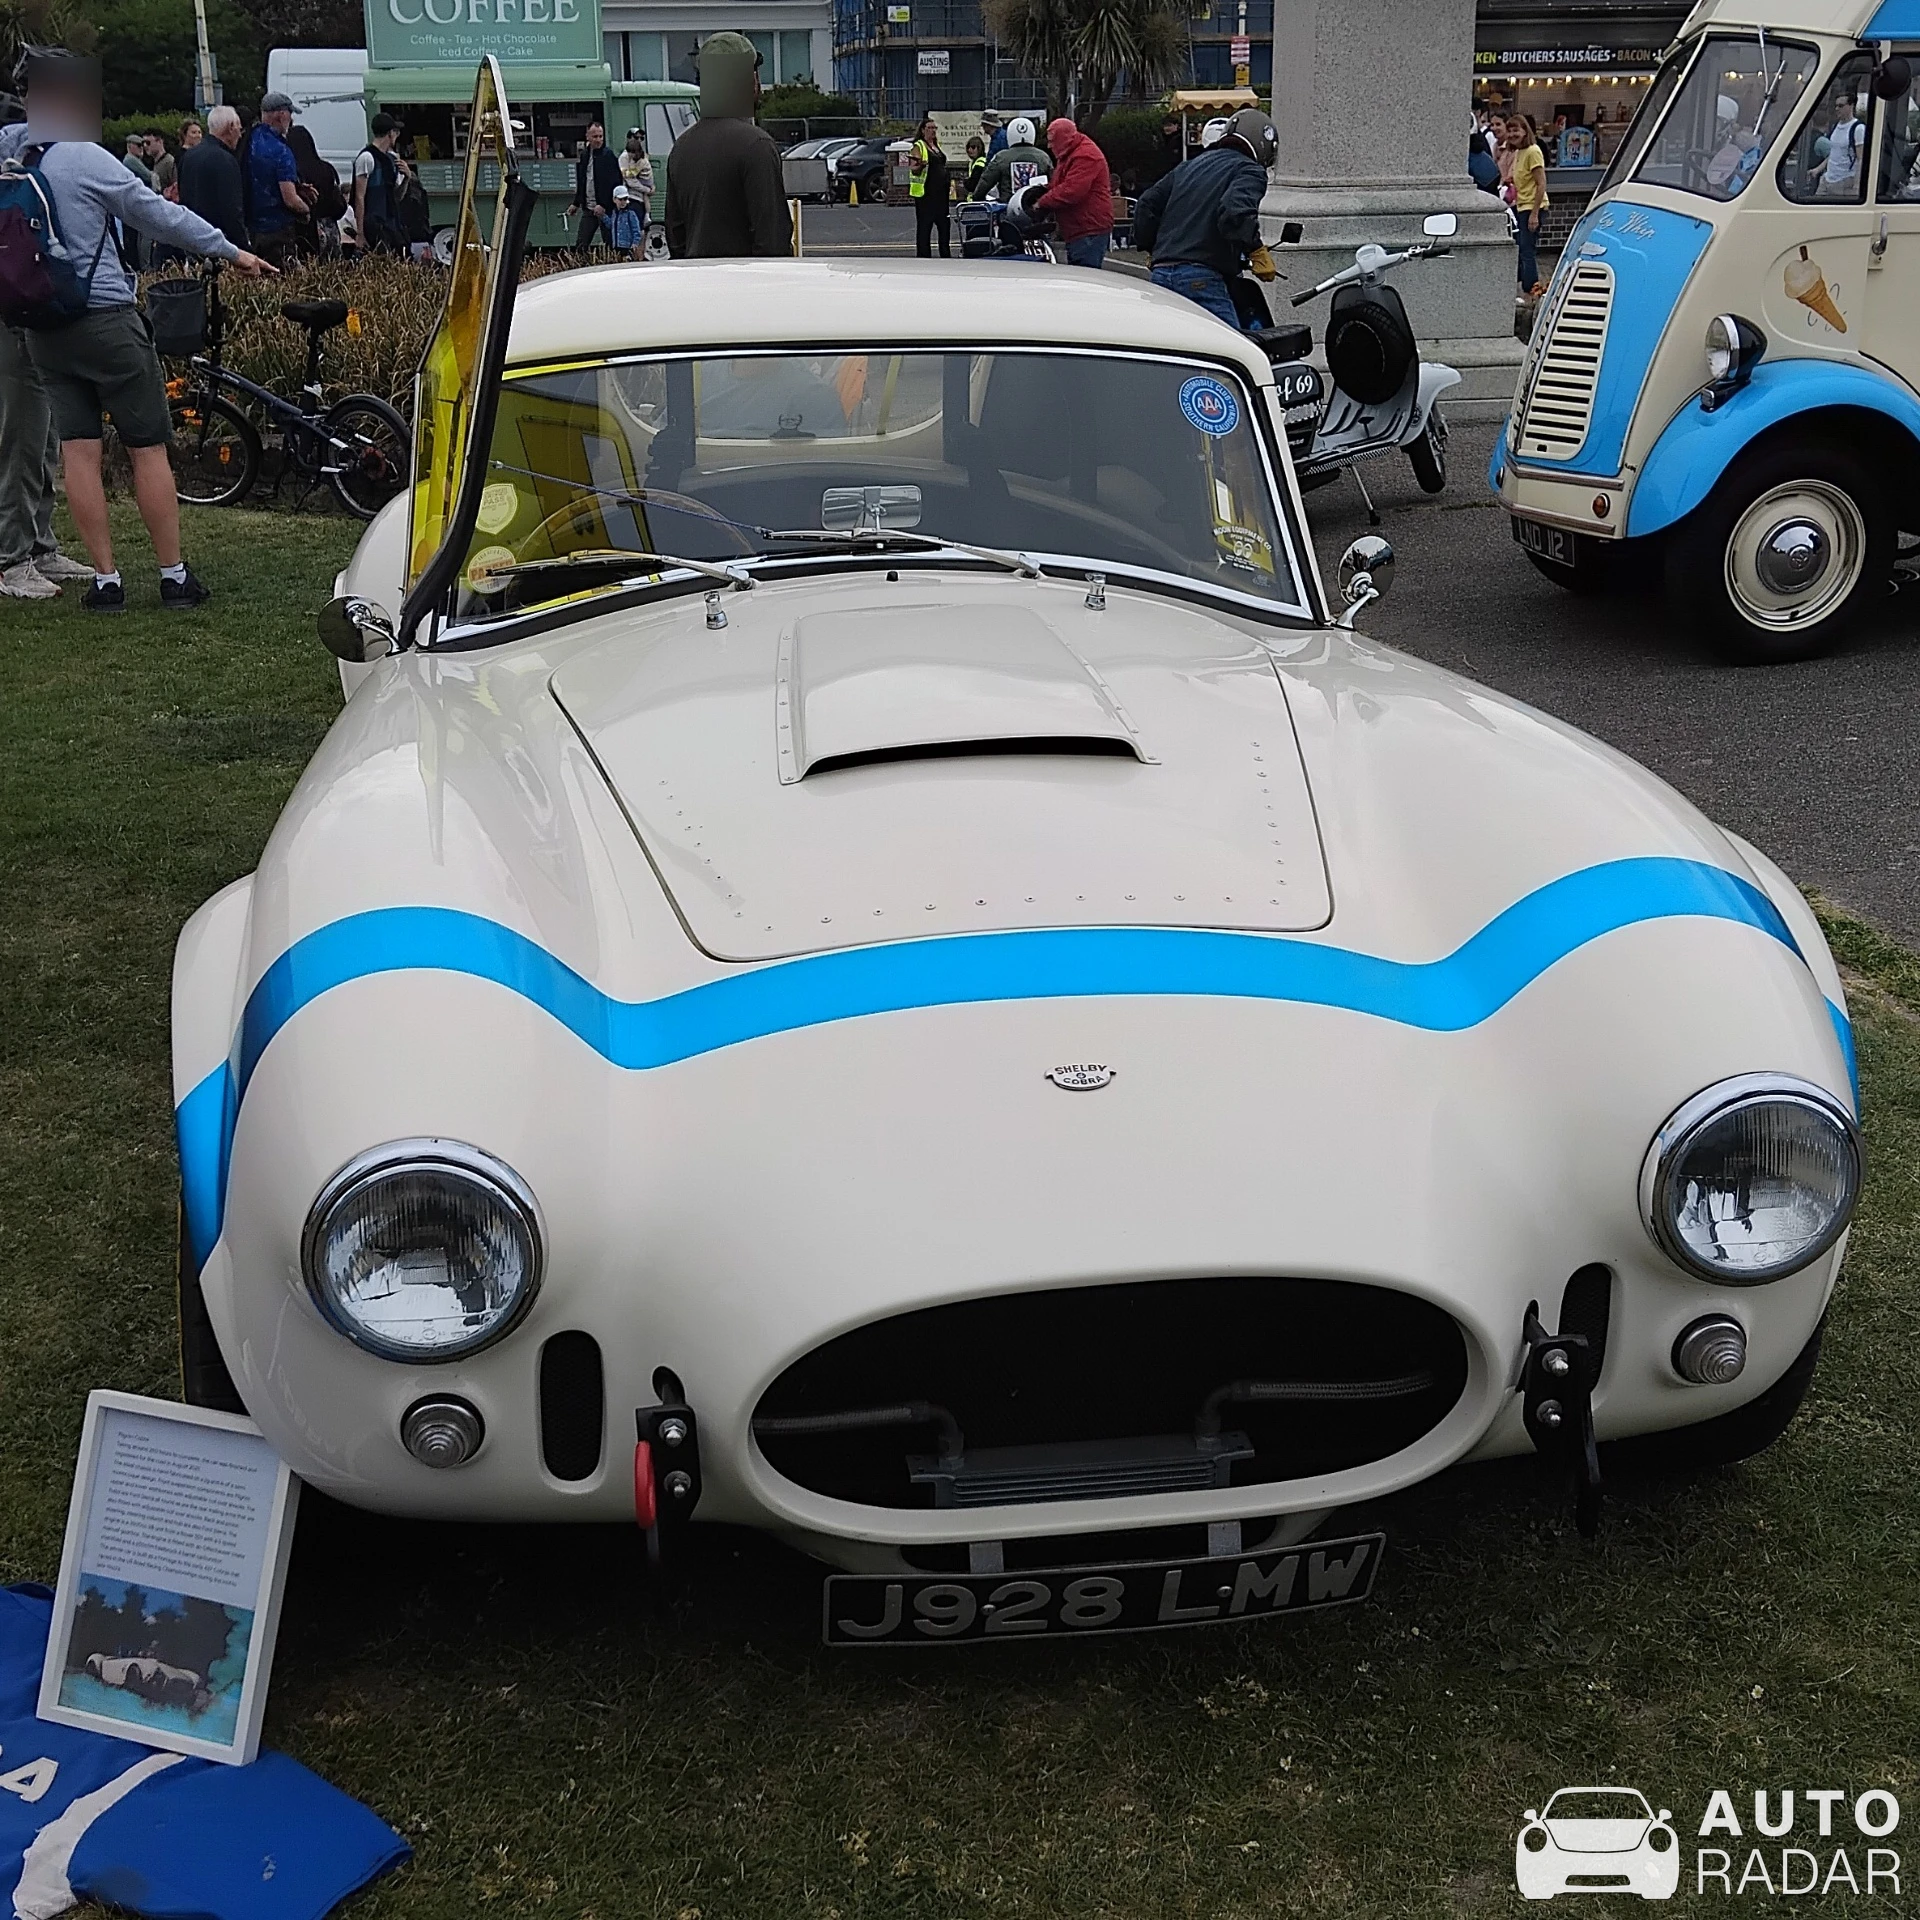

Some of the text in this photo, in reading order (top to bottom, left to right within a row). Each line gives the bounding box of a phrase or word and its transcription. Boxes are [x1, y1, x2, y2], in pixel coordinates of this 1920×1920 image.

[388, 0, 581, 25] COFFEE
[410, 33, 557, 45] Coffee Tea Hot Chocolate
[438, 46, 461, 57] Iced
[507, 46, 534, 56] Cake
[1473, 51, 1497, 64] KEN
[1502, 51, 1555, 63] BUTCHERS
[1556, 49, 1610, 63] SAUSAGES
[1617, 49, 1651, 62] BACON
[919, 57, 949, 66] AUSTINS
[1182, 379, 1231, 401] AUTOMOBILE CLUB
[1296, 374, 1313, 394] 69
[1197, 396, 1223, 411] AAA
[1182, 402, 1237, 432] SOUTHERN CALIFORNIA
[1213, 526, 1231, 537] MOON
[1547, 529, 1565, 560] 112
[1054, 1064, 1108, 1075] SHELBY
[1063, 1075, 1104, 1085] COBRA
[837, 1544, 1371, 1638] J928 LMW
